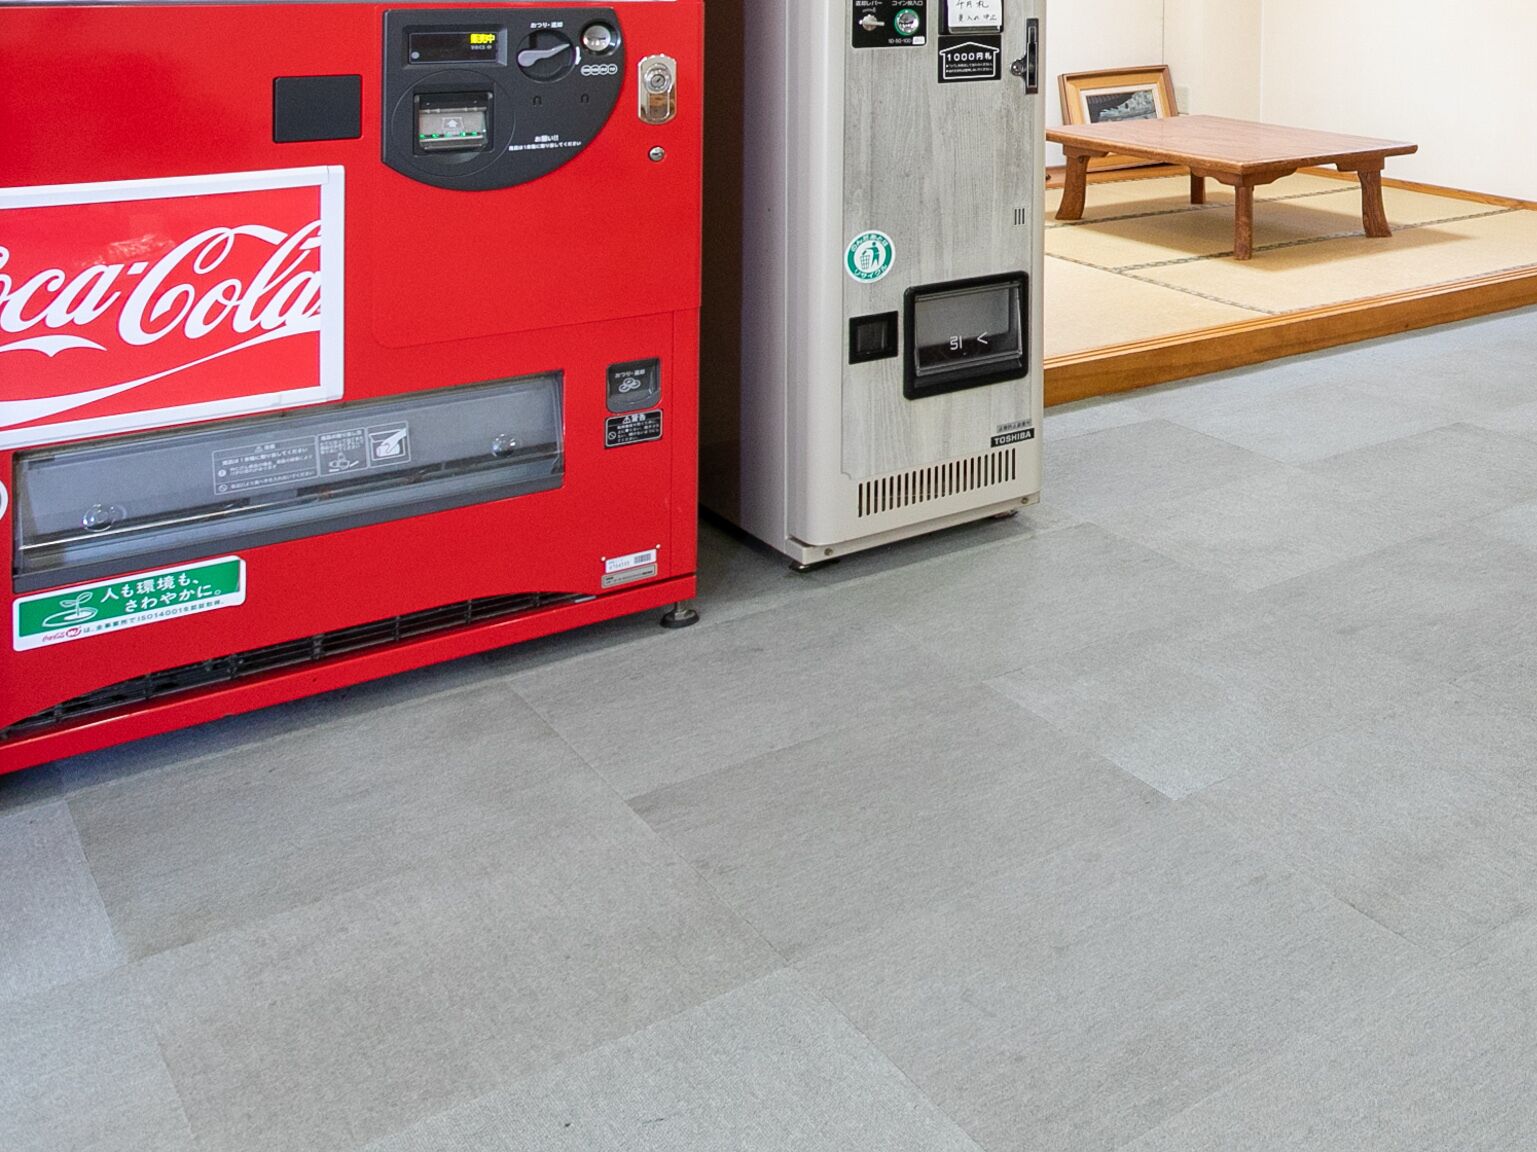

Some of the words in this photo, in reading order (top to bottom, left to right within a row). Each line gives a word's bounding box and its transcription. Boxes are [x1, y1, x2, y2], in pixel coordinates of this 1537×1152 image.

[946, 52, 993, 62] 1000円札
[994, 430, 1032, 446] TOSHIBA
[100, 572, 200, 603] 人も環境も、
[124, 583, 222, 613] さわやかに。
